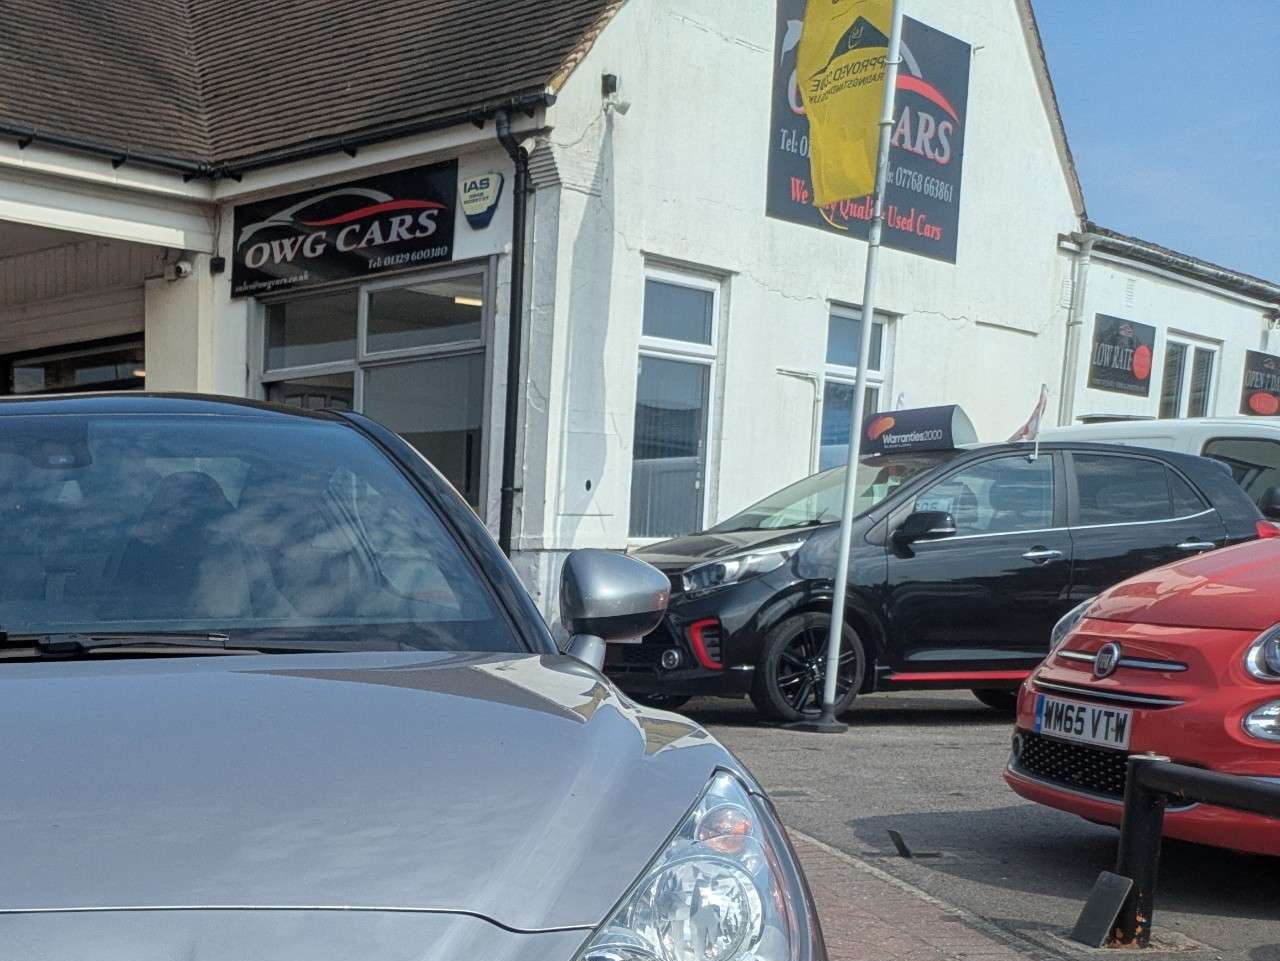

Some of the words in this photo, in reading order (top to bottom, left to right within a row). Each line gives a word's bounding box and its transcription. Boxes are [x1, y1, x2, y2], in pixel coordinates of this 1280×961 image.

[781, 128, 797, 153] Tel:
[891, 105, 952, 164] ARS
[464, 178, 490, 193] IAS
[895, 167, 923, 193] 07768
[923, 176, 954, 203] 663861
[791, 176, 809, 204] We
[887, 205, 916, 232] Used
[917, 214, 942, 240] Cars
[244, 232, 326, 269] OWG
[336, 209, 439, 252] CARS
[1093, 342, 1113, 368] LOW
[1112, 344, 1134, 370] RATE
[883, 430, 943, 444] Warranties2000
[1044, 700, 1086, 736] WM65
[1091, 709, 1128, 743] VTW
